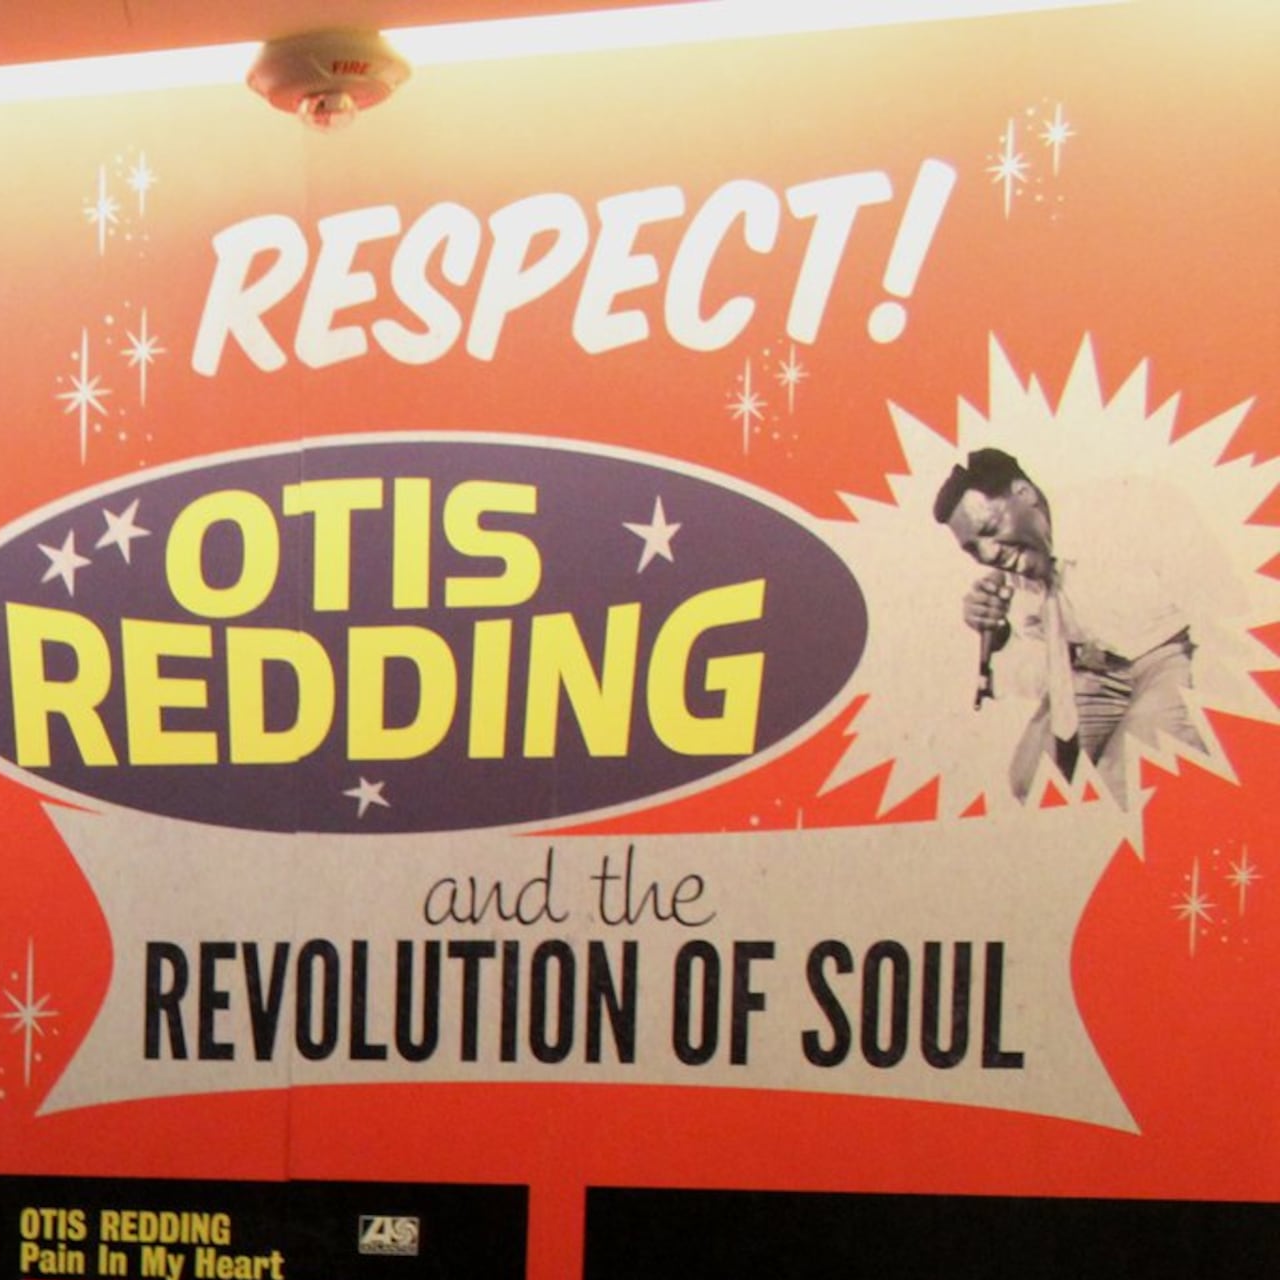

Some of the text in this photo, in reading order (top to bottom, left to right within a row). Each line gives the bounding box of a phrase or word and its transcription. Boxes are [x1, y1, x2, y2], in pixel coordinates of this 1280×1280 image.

[191, 158, 956, 377] RESPECT!
[164, 477, 542, 618] OTIS
[5, 579, 765, 767] REDDING
[422, 844, 717, 928] and the
[142, 938, 1024, 1070] REVOLUTION OF SOUL
[20, 1207, 231, 1246] OTIS REDDING
[20, 1242, 85, 1274] Pain
[98, 1244, 127, 1276] In
[195, 1247, 285, 1280] Heart
